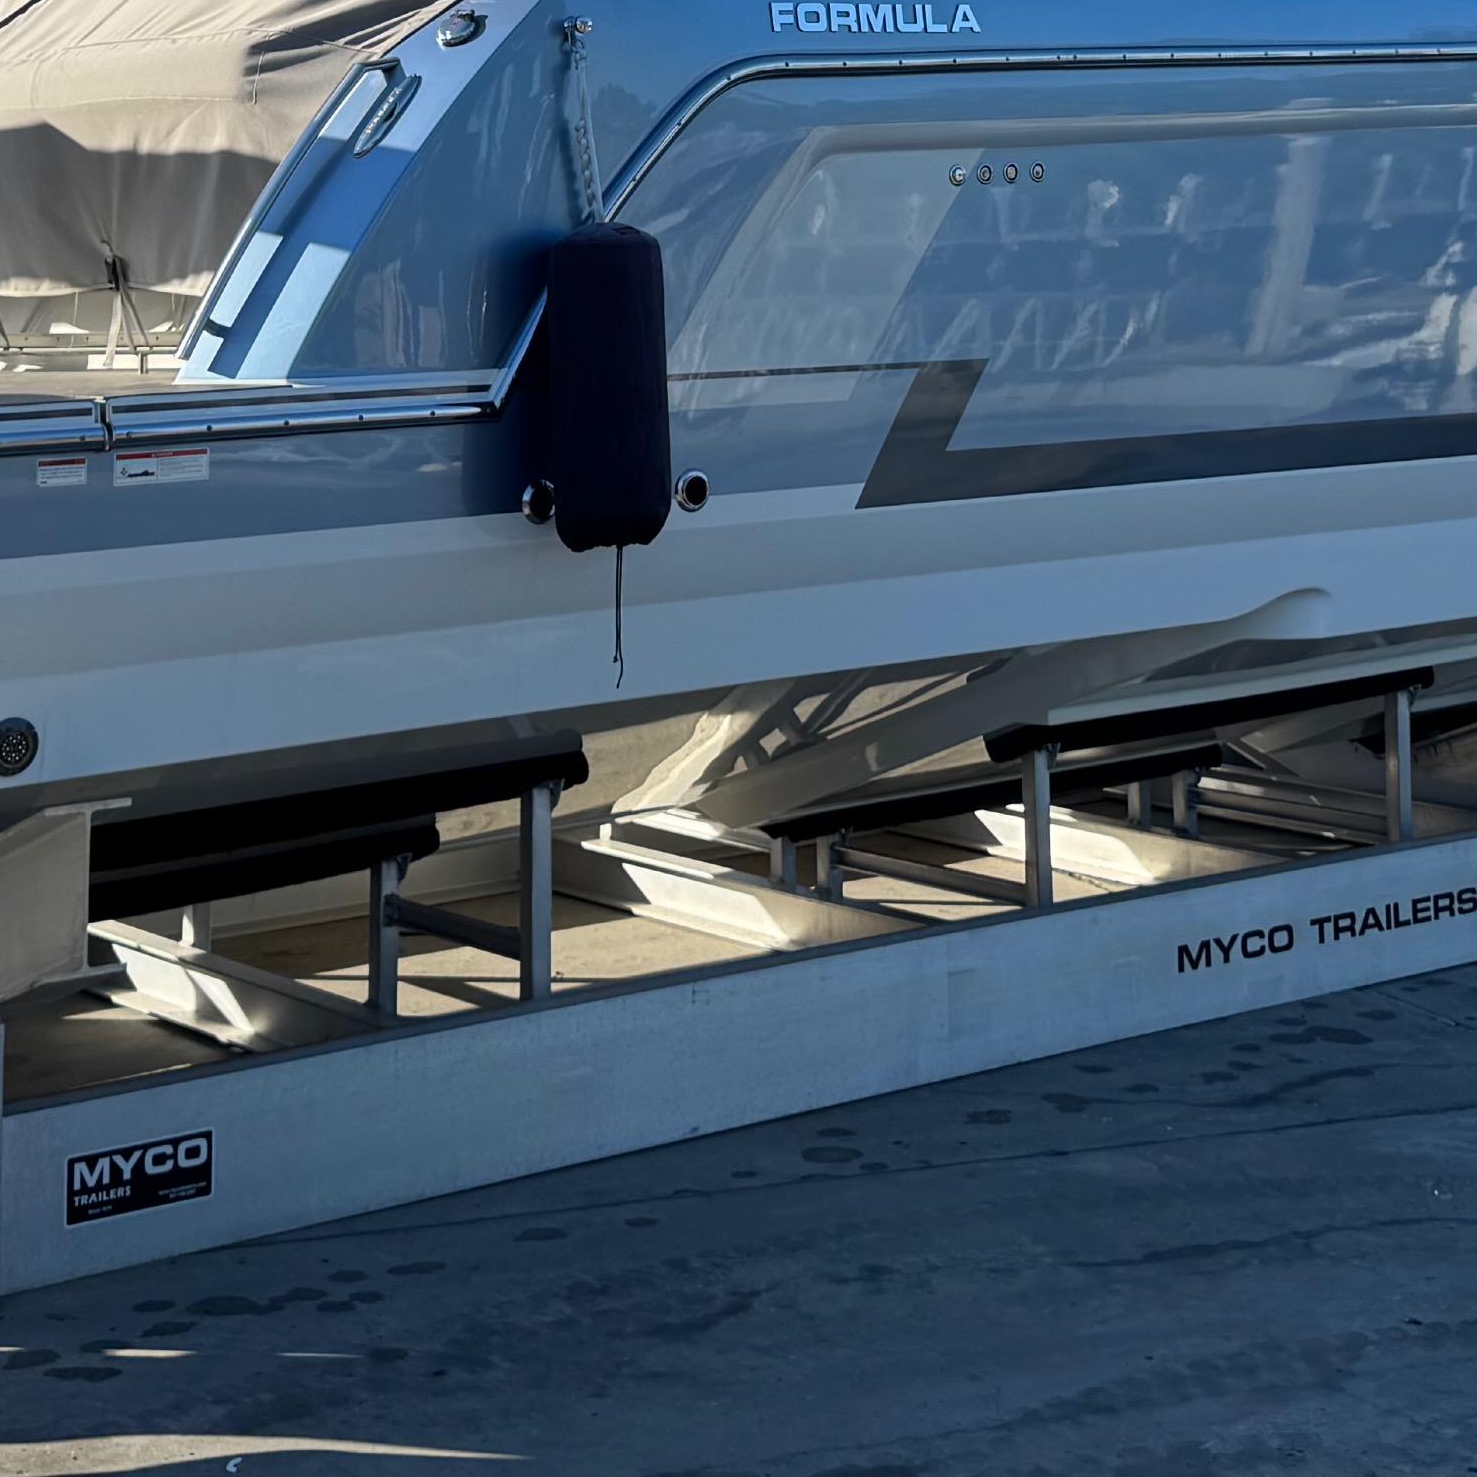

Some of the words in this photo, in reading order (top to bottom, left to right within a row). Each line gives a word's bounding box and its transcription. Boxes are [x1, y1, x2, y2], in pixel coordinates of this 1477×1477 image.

[769, 2, 982, 33] FORMULA
[1177, 923, 1294, 973] MYCO
[73, 1137, 209, 1191] MYCO
[73, 1185, 131, 1207] TRAILERS
